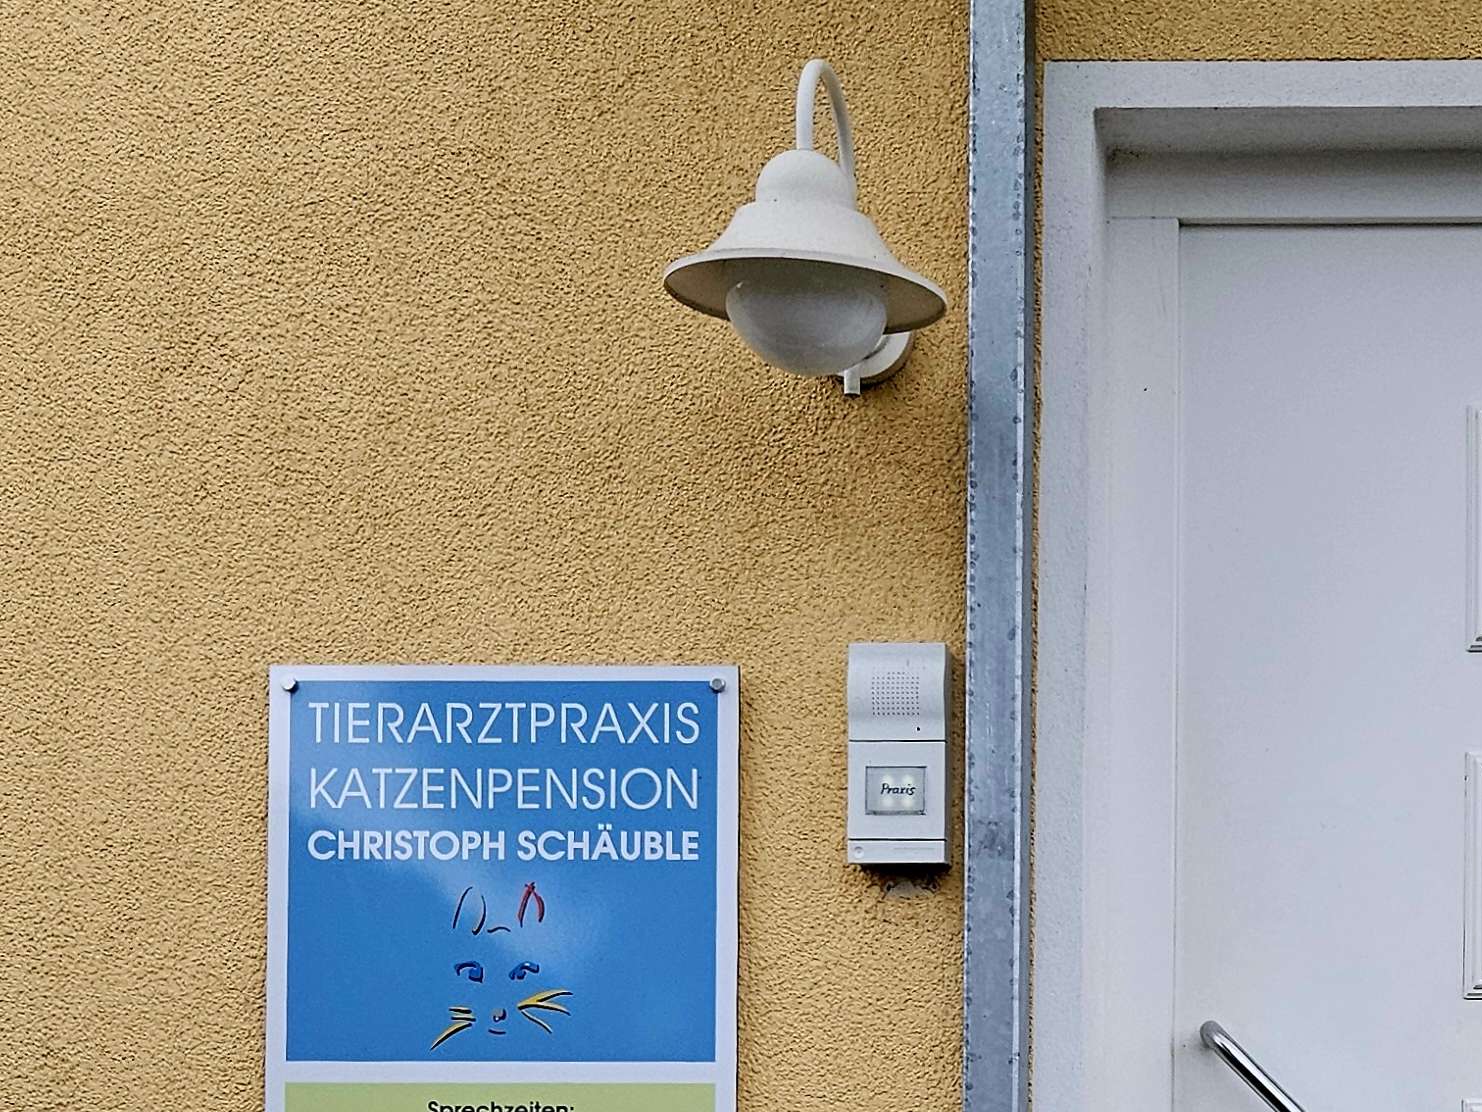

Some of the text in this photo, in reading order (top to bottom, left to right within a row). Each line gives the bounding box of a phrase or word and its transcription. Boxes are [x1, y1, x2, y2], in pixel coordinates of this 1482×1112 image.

[308, 702, 699, 744] TIERARZTPRAXIS
[310, 767, 698, 810] KATZENPENSION
[880, 782, 917, 796] Praxis
[308, 823, 699, 861] CHRISTOPH SCHÄUBLE
